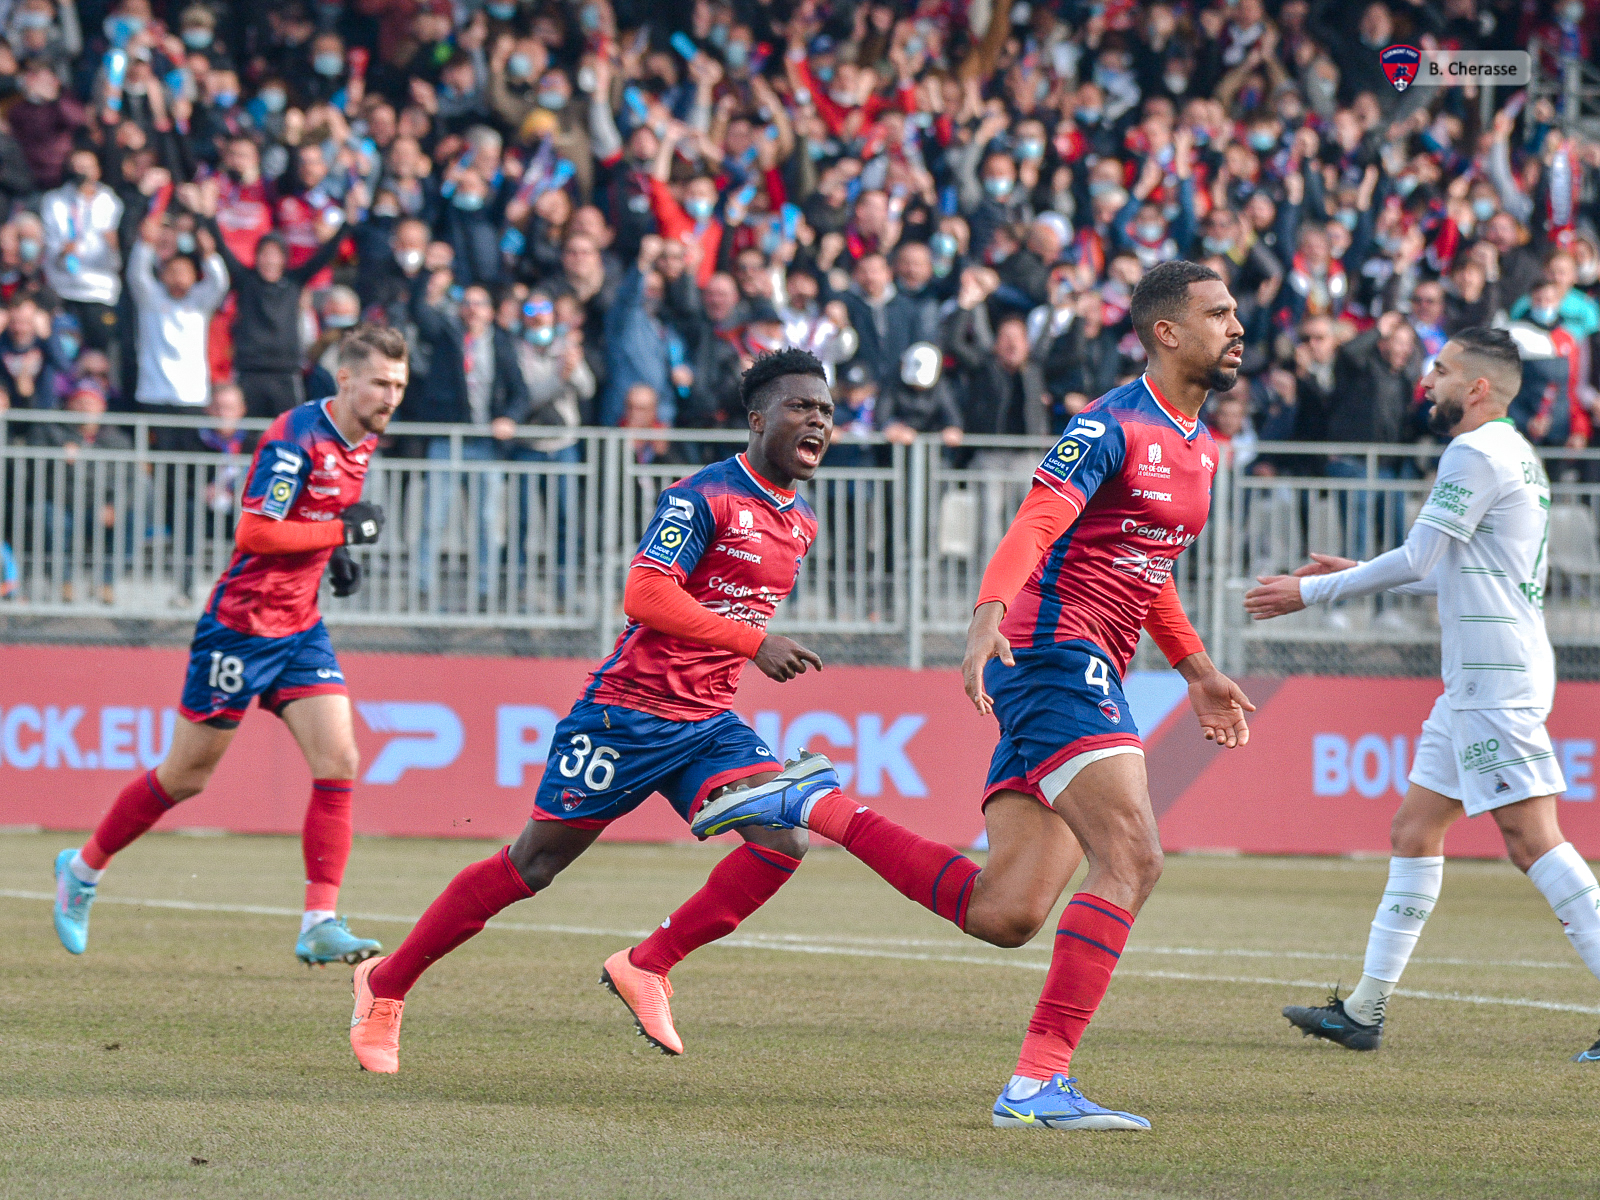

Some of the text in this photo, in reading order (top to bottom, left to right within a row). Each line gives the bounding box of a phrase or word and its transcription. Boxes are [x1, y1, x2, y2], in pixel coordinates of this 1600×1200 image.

[1142, 489, 1173, 503] PATRICK
[1440, 482, 1473, 499] SMART
[727, 547, 763, 565] PATRICK
[708, 576, 753, 598] Crédit
[208, 650, 245, 694] 18
[1084, 654, 1110, 696] 4
[559, 733, 621, 791] 36
